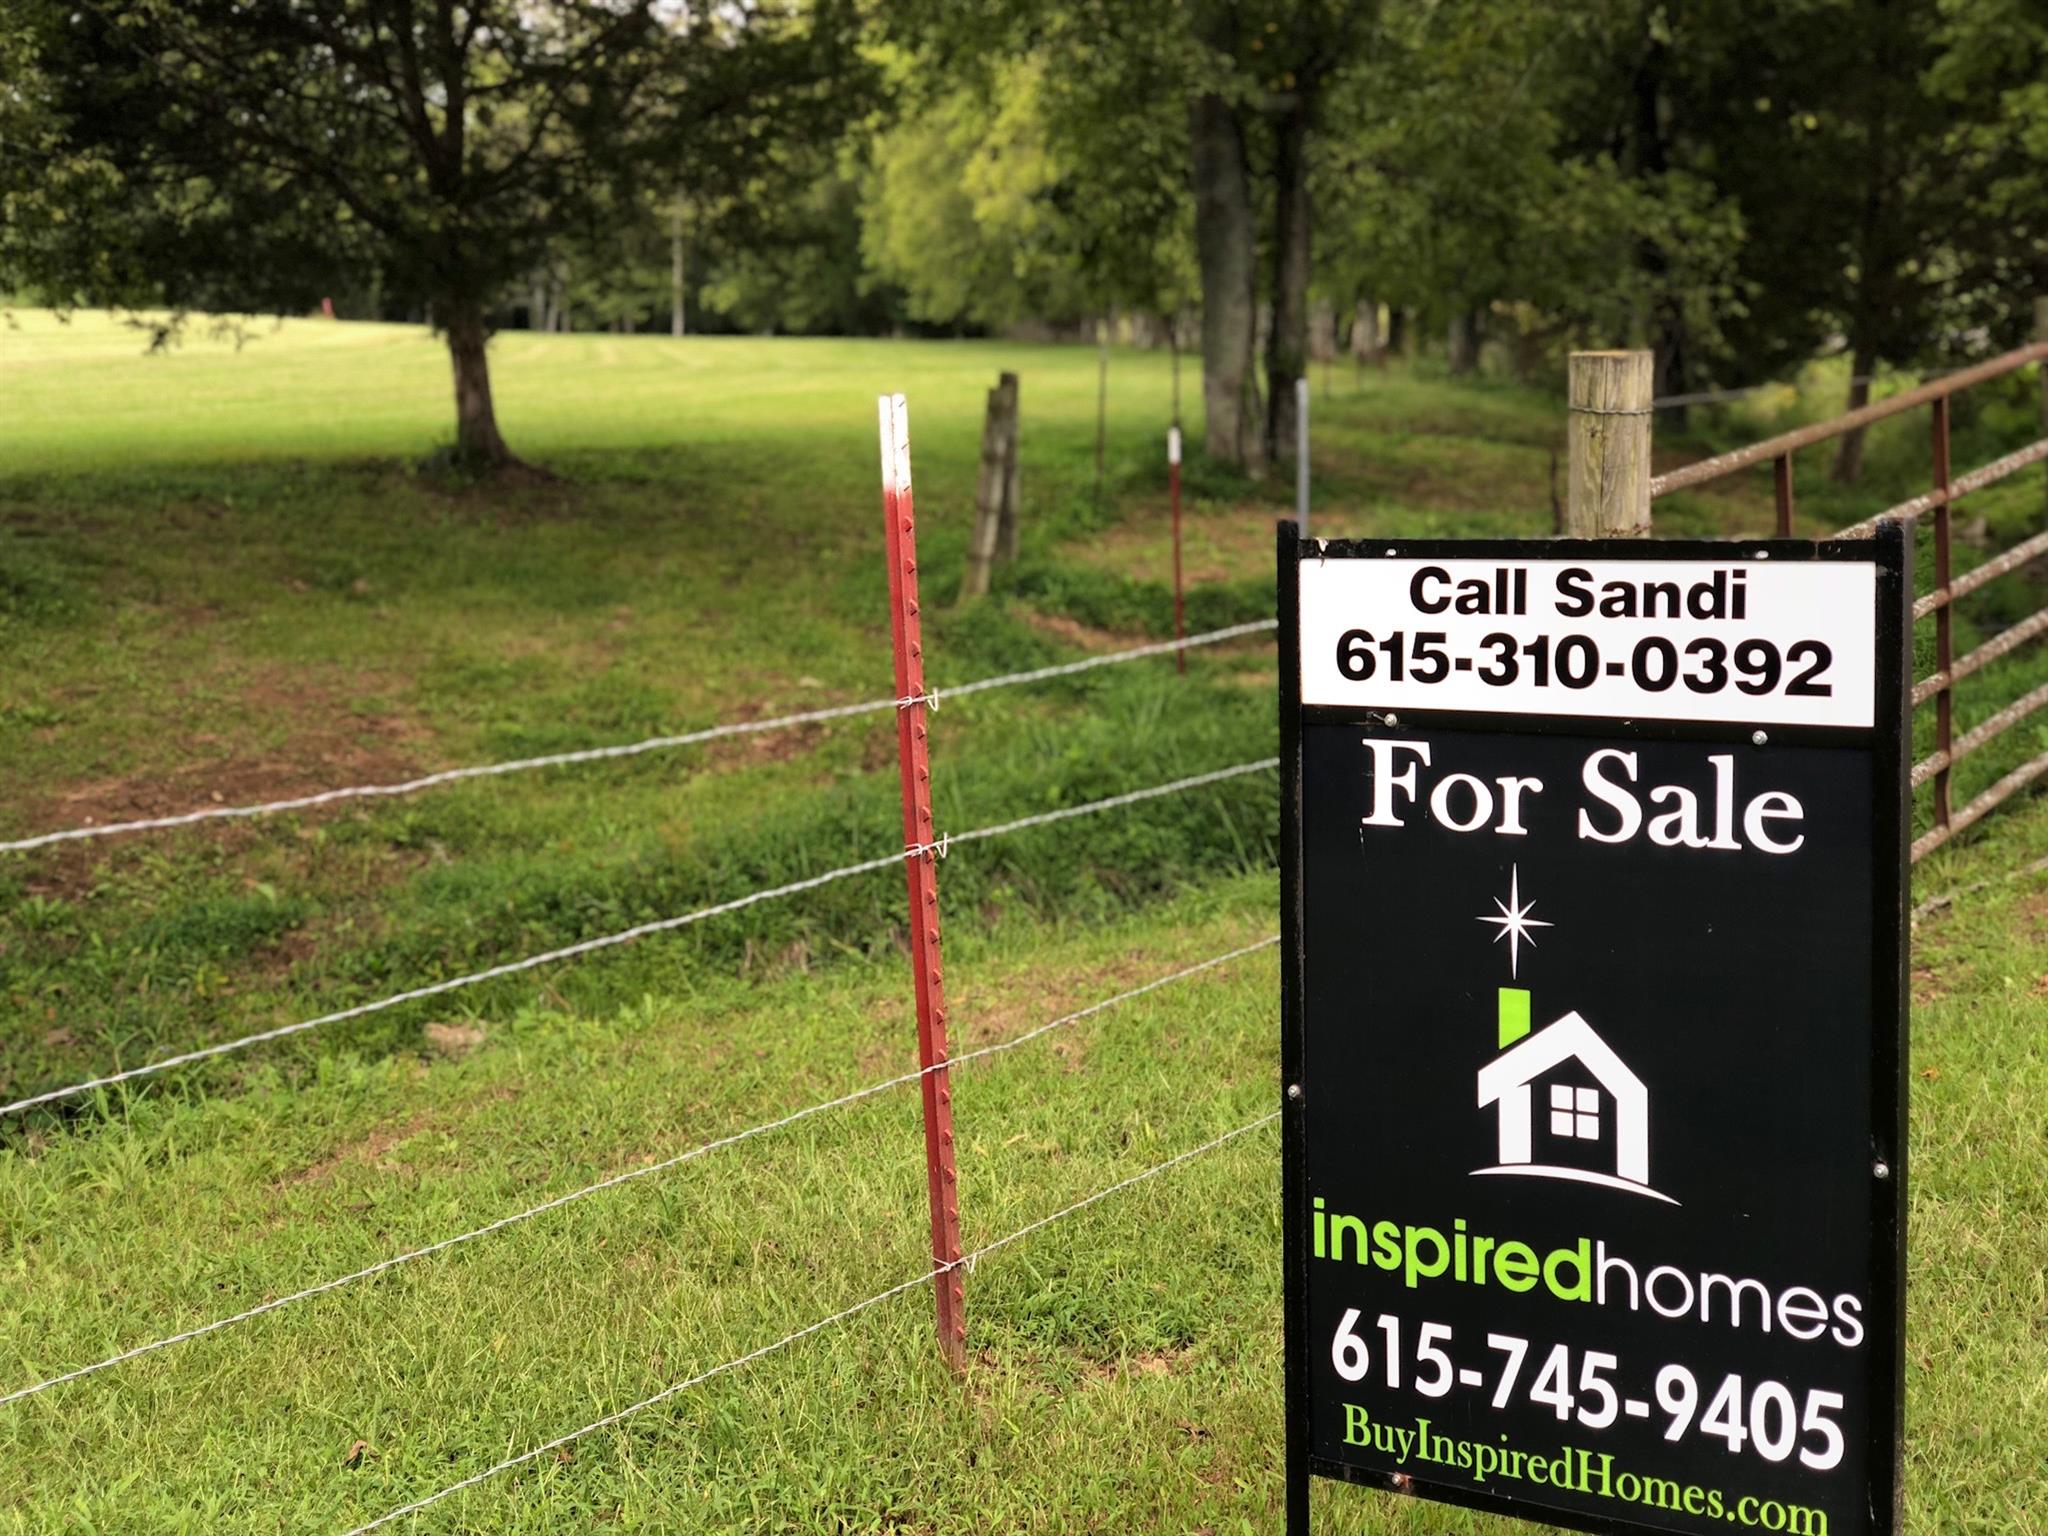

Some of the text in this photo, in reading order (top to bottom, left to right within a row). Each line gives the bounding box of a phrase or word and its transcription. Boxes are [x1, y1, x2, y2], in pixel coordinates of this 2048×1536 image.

[1409, 567, 1747, 620] Call Sandi
[1336, 629, 1834, 698] 615-310-0392
[1361, 738, 1806, 855] For Sale
[1313, 1198, 1865, 1348] inspiredhomes
[1331, 1308, 1845, 1471] 615-745-9405
[1342, 1403, 1830, 1536] BuyInspiredHomes.com
